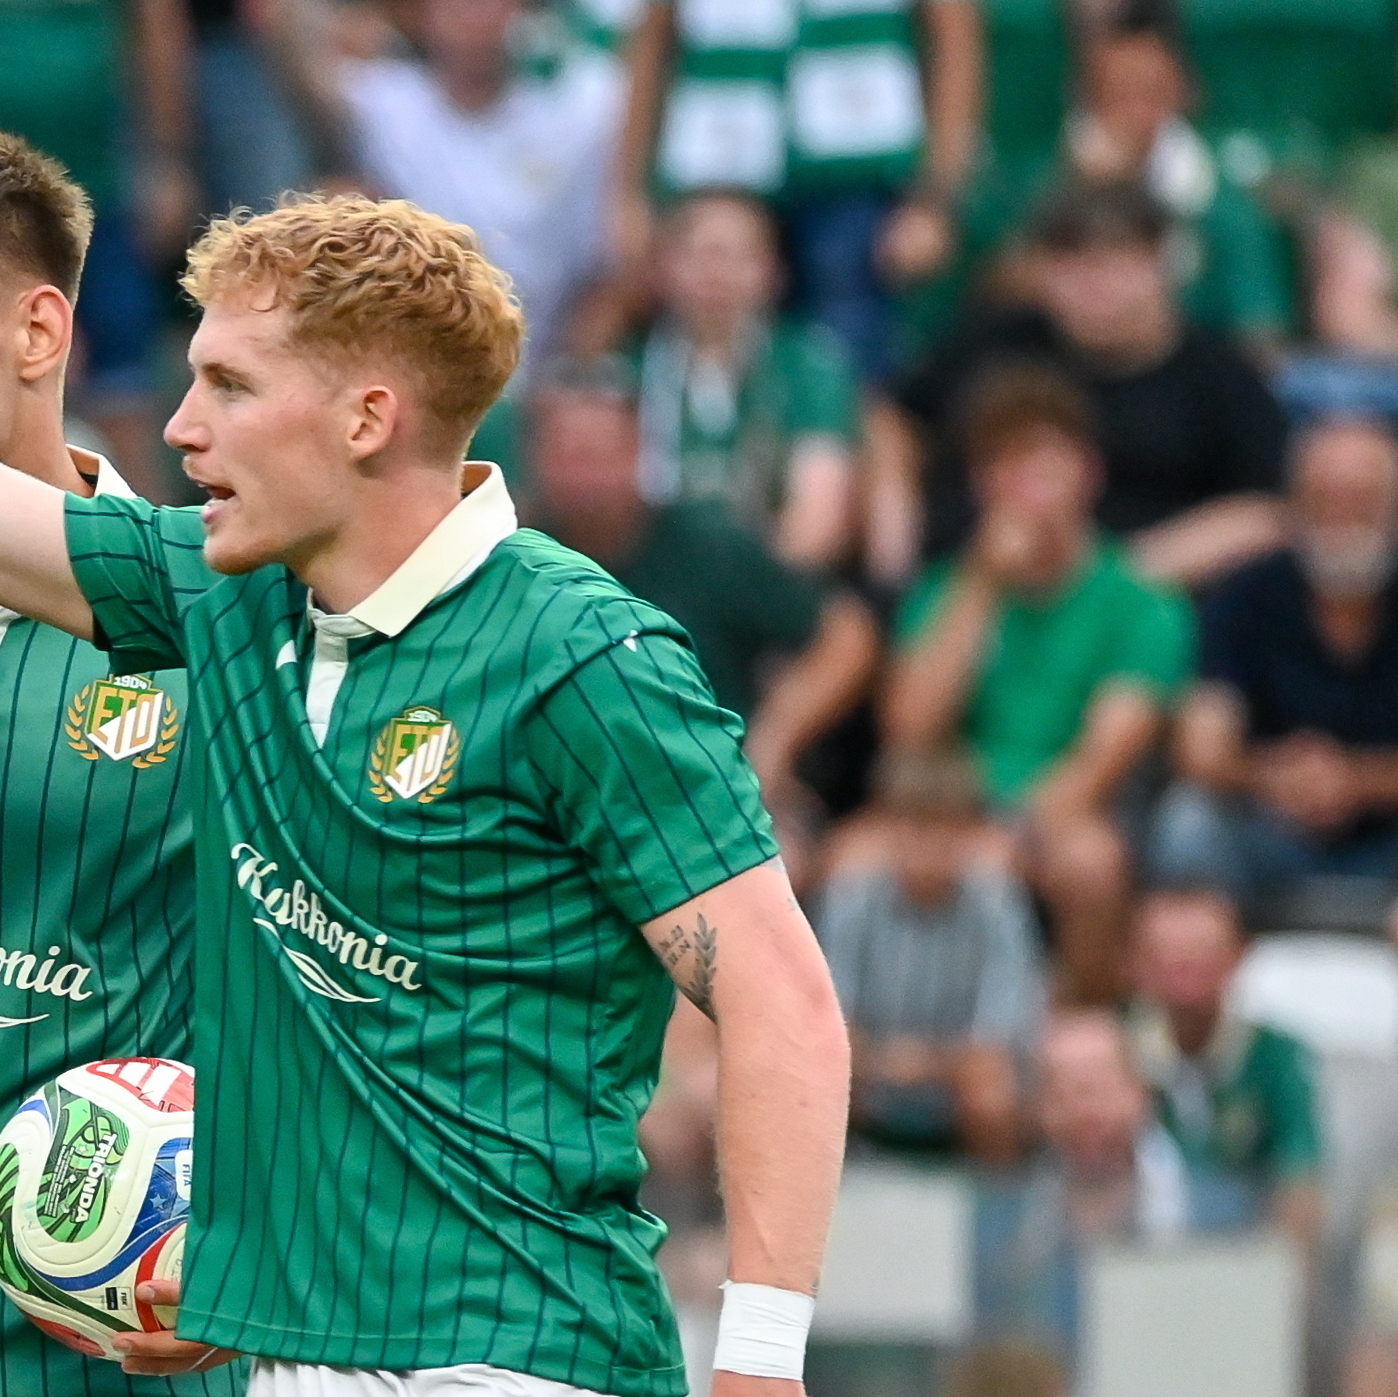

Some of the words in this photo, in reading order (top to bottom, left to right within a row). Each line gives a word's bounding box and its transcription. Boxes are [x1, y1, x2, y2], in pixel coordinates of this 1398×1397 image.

[92, 686, 156, 754] ETO
[389, 724, 444, 792] ETO
[231, 843, 422, 990] Kukkonia
[74, 1132, 118, 1223] TRIONDA
